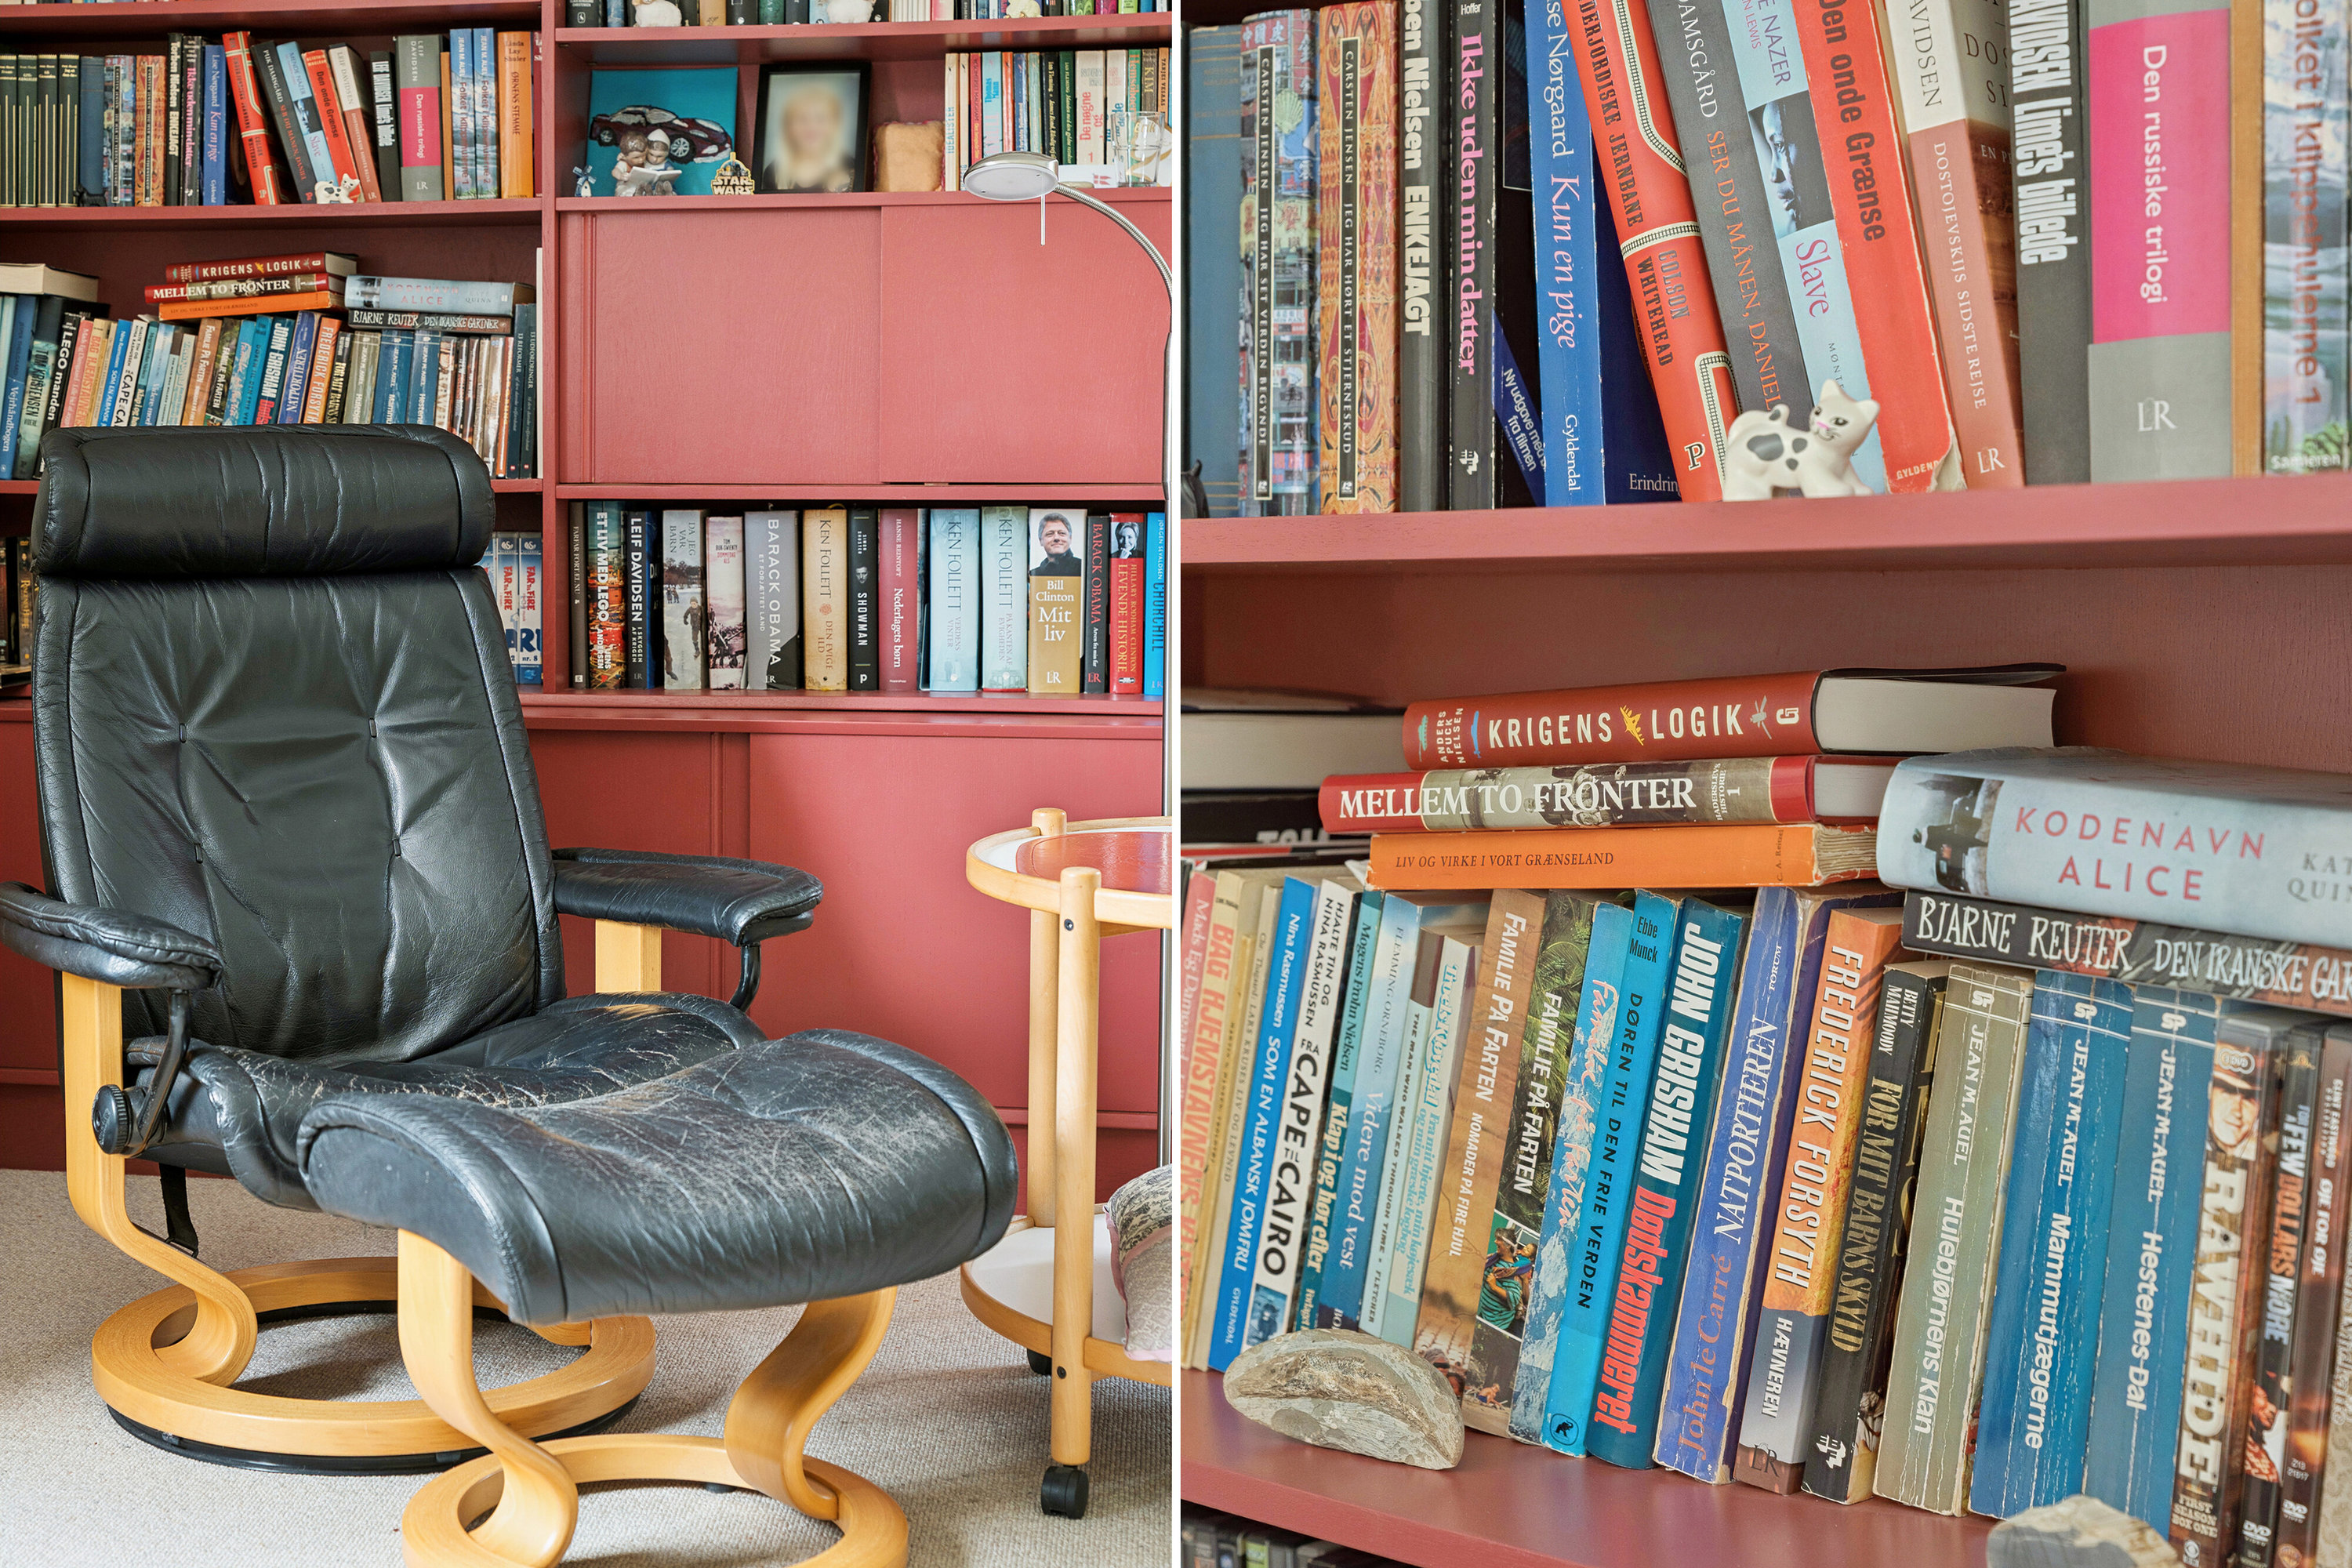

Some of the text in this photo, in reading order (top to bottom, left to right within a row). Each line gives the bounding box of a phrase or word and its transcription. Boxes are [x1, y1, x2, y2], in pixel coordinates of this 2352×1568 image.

[1461, 2, 1482, 15] Hoffer
[1745, 15, 1762, 49] LEWIS
[409, 41, 419, 82] DAVIDSEN
[1145, 66, 1155, 93] KIM
[1762, 13, 1791, 86] NAZER
[168, 42, 180, 157] Torben Nielsen ENKEJAGT
[316, 71, 339, 138] Den onde Grænse
[511, 71, 521, 136] ØRNENS STEMME
[1345, 50, 1354, 120] CARSTEN
[1260, 133, 1269, 189] JENSEN
[1609, 132, 1643, 227] JERNBANE
[1830, 53, 1886, 242] onde Grænse
[2140, 45, 2169, 304] Den russiske trilogi
[712, 176, 750, 187] STAR
[712, 184, 754, 195] WARS
[1405, 57, 1431, 336] Nielsen ENKEJAGT
[1459, 32, 1483, 376] Ikke uden min datter
[1543, 33, 1583, 349] Nørgaard Kun en pige
[1260, 208, 1269, 234] JEG
[2019, 178, 2078, 266] billede
[153, 279, 291, 299] MELLEM TO FRONTER
[202, 260, 301, 278] KRIGENS LOGIK
[1259, 277, 1268, 303] SET
[1344, 274, 1352, 318] HØRT
[1658, 249, 1690, 320] COLSON
[1706, 131, 1781, 411] SER DU MÅNEN, DANIEL
[1795, 238, 1830, 318] Slave
[1933, 142, 1987, 410] DOSTOJEVSKIJS SIDSTE REJSE
[353, 310, 419, 327] BJARNE REUTER
[1259, 310, 1268, 369] VERDEN
[1344, 324, 1352, 343] ET
[1638, 256, 1674, 367] WHITEHEAD
[56, 331, 74, 368] LEGO
[2, 386, 20, 452] Vejrhåndbogen
[46, 370, 64, 421] manden
[1258, 376, 1268, 446] BEGYNDE
[1343, 347, 1352, 455] STJERNESKUD
[2136, 397, 2177, 432] LR
[1507, 414, 1523, 437] fra
[1515, 433, 1537, 472] filmen
[1564, 414, 1581, 492] Gyldendal
[1976, 447, 2005, 474] LR
[597, 512, 610, 622] ET LIV MED LEGO
[630, 517, 643, 622] LEIF DAVIDSEN
[758, 554, 764, 564] ET
[819, 520, 832, 598] KEN FOLLETT
[947, 521, 962, 611] KEN FOLLETT
[1047, 580, 1064, 590] Bill
[768, 519, 782, 666] BARACK OBAMA
[858, 592, 868, 646] SHOWMAN
[891, 588, 903, 643] Nederlagets
[1035, 591, 1075, 602] Clinton
[1038, 606, 1072, 622] Mit
[1117, 564, 1128, 673] LEVENDE HISTORIE
[1152, 582, 1164, 652] CHURCHILL
[893, 644, 903, 668] børn
[1044, 625, 1065, 641] liv
[1436, 710, 1448, 763] ANDERS
[1445, 717, 1454, 754] PUCK
[1457, 707, 1465, 764] NIELSEN
[1489, 704, 1744, 750] KRIGENS LOGIK
[1339, 777, 1697, 818] MELLEM TO FRONTER
[1709, 762, 1722, 822] HADERSLEVS
[1719, 769, 1728, 815] HISTORIE
[1395, 851, 1615, 868] LIV OG VIRKE I VORT GRÆNSELAND
[2015, 807, 2265, 860] KODENAVN
[2058, 855, 2204, 901] ALICE
[1628, 938, 1658, 964] Munck
[1636, 916, 1658, 939] Ebbe
[1916, 895, 2308, 993] BJARNE REUTER DEN IRANSKE
[1768, 943, 1783, 993] FORUM
[1475, 911, 1527, 1102] FAMILIE PÅ FARTEN
[1878, 984, 1903, 1056] MAHMOODY
[1900, 988, 1919, 1029] BETTY
[1283, 1051, 1319, 1149] CAPE
[1713, 1013, 1778, 1245] NATPORTIEREN
[1775, 945, 1864, 1289] FREDERICK FORSYTH
[1577, 993, 1643, 1309] DØREN TIL DEN FRIE VERDEN
[1595, 921, 1722, 1436] JOHN GRISHAM Dødskammeret
[1262, 1161, 1301, 1276] CAIRO
[1831, 1076, 1904, 1353] FOR MIT BARNS SKYLD
[1914, 1024, 1986, 1435] JEAN M. AUEL Hulebjørnens Klan
[2024, 1211, 2072, 1450] Mammutjægerne
[2125, 1230, 2164, 1411] Hestenes Dal
[2179, 1160, 2248, 1486] RAWHIDE
[1677, 1252, 1733, 1461] John le Carré
[1761, 1316, 1794, 1419] HÆVNEREN
